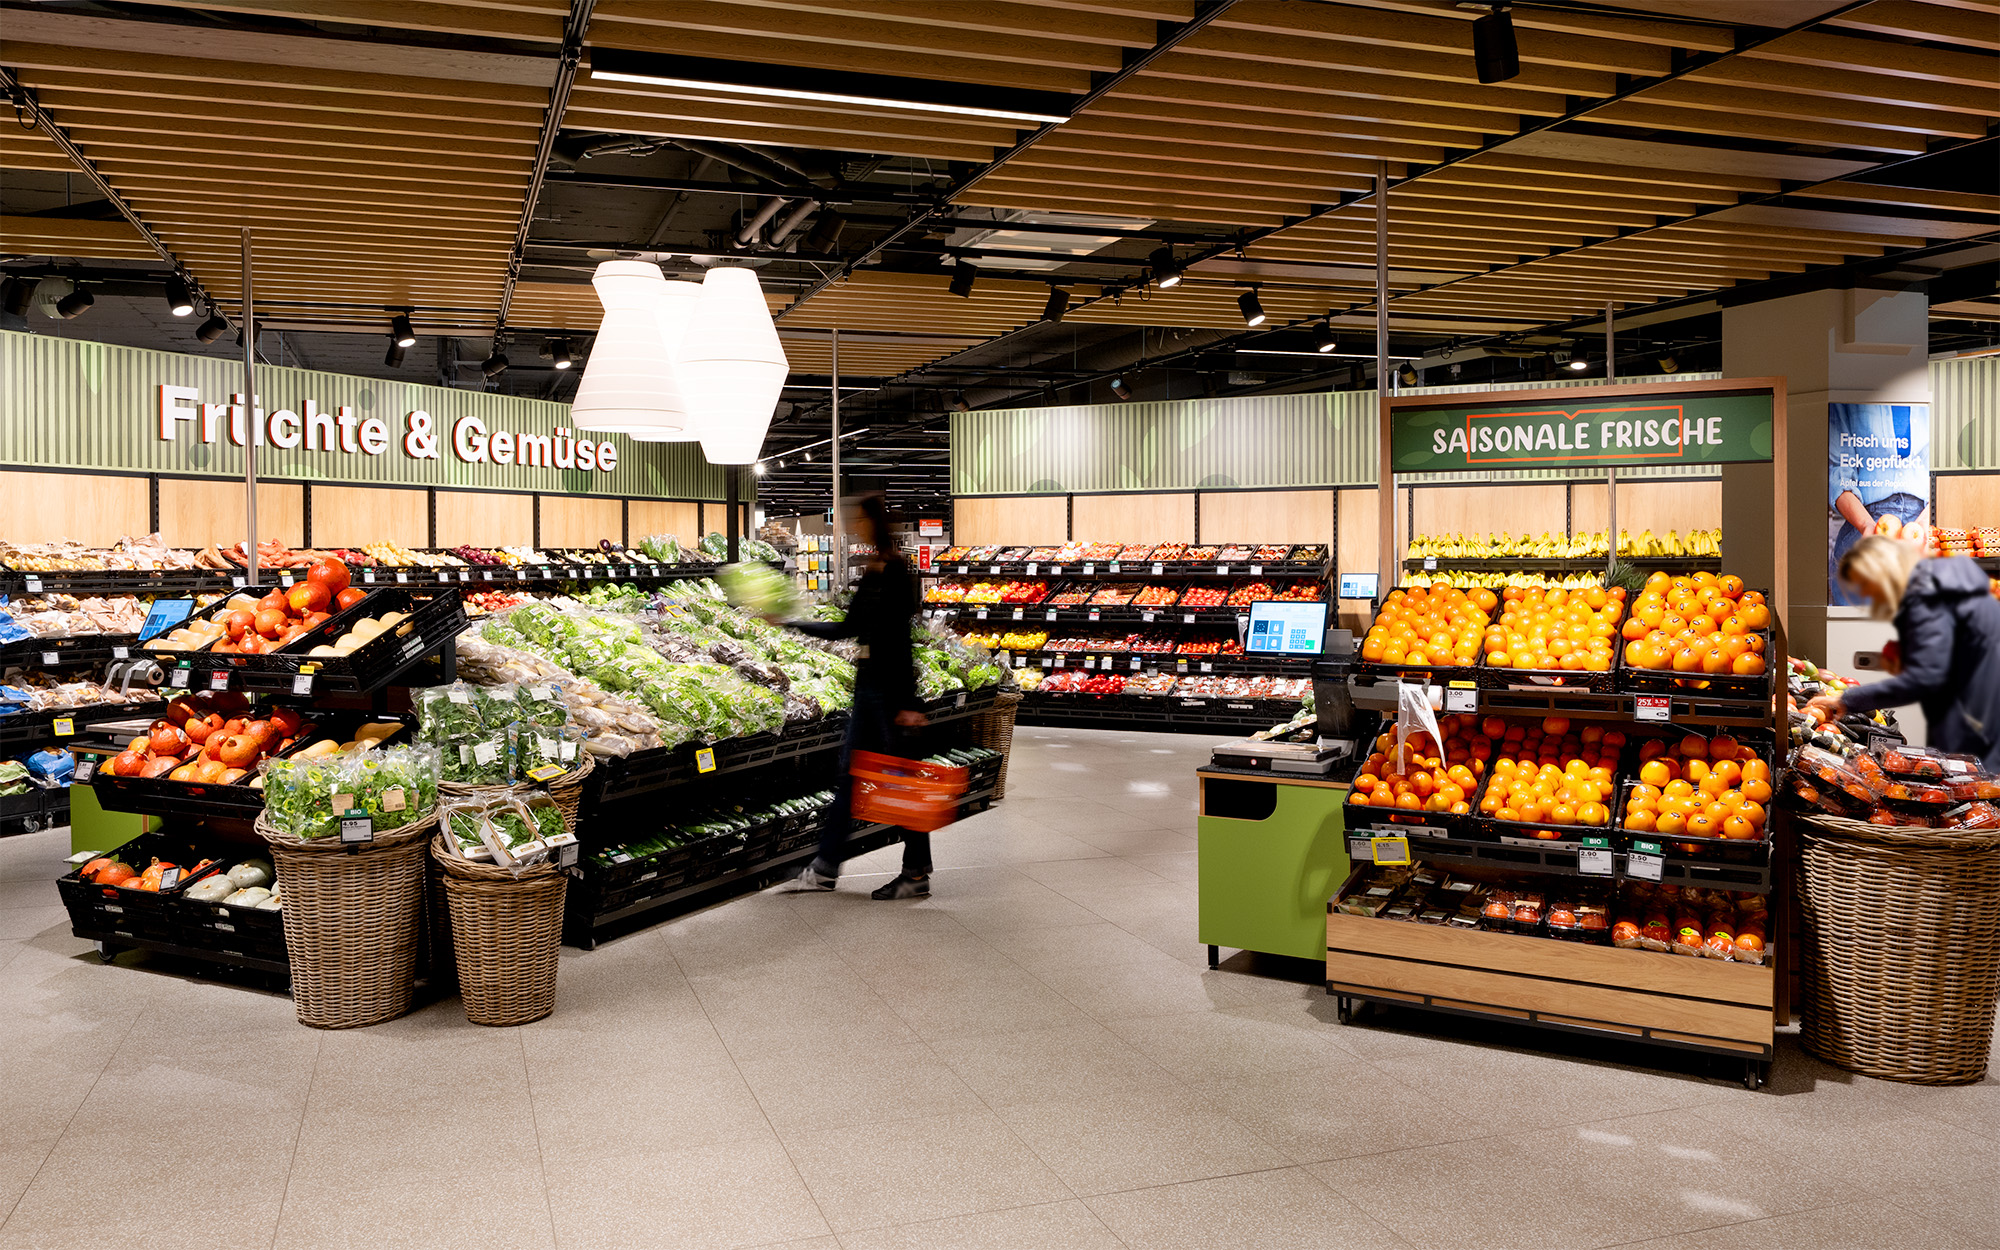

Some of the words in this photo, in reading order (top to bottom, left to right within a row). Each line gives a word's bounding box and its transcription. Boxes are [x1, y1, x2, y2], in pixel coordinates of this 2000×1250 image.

[158, 384, 388, 456] Früchte
[404, 410, 441, 460] &
[452, 415, 618, 473] Gemüse
[1432, 422, 1590, 455] SAISONALE
[1601, 416, 1723, 449] FRISCHE
[1840, 432, 1878, 448] Frisch
[1882, 436, 1909, 449] ums
[1840, 453, 1863, 468] Eck
[1872, 479, 1884, 488] der
[1638, 698, 1652, 706] 25%
